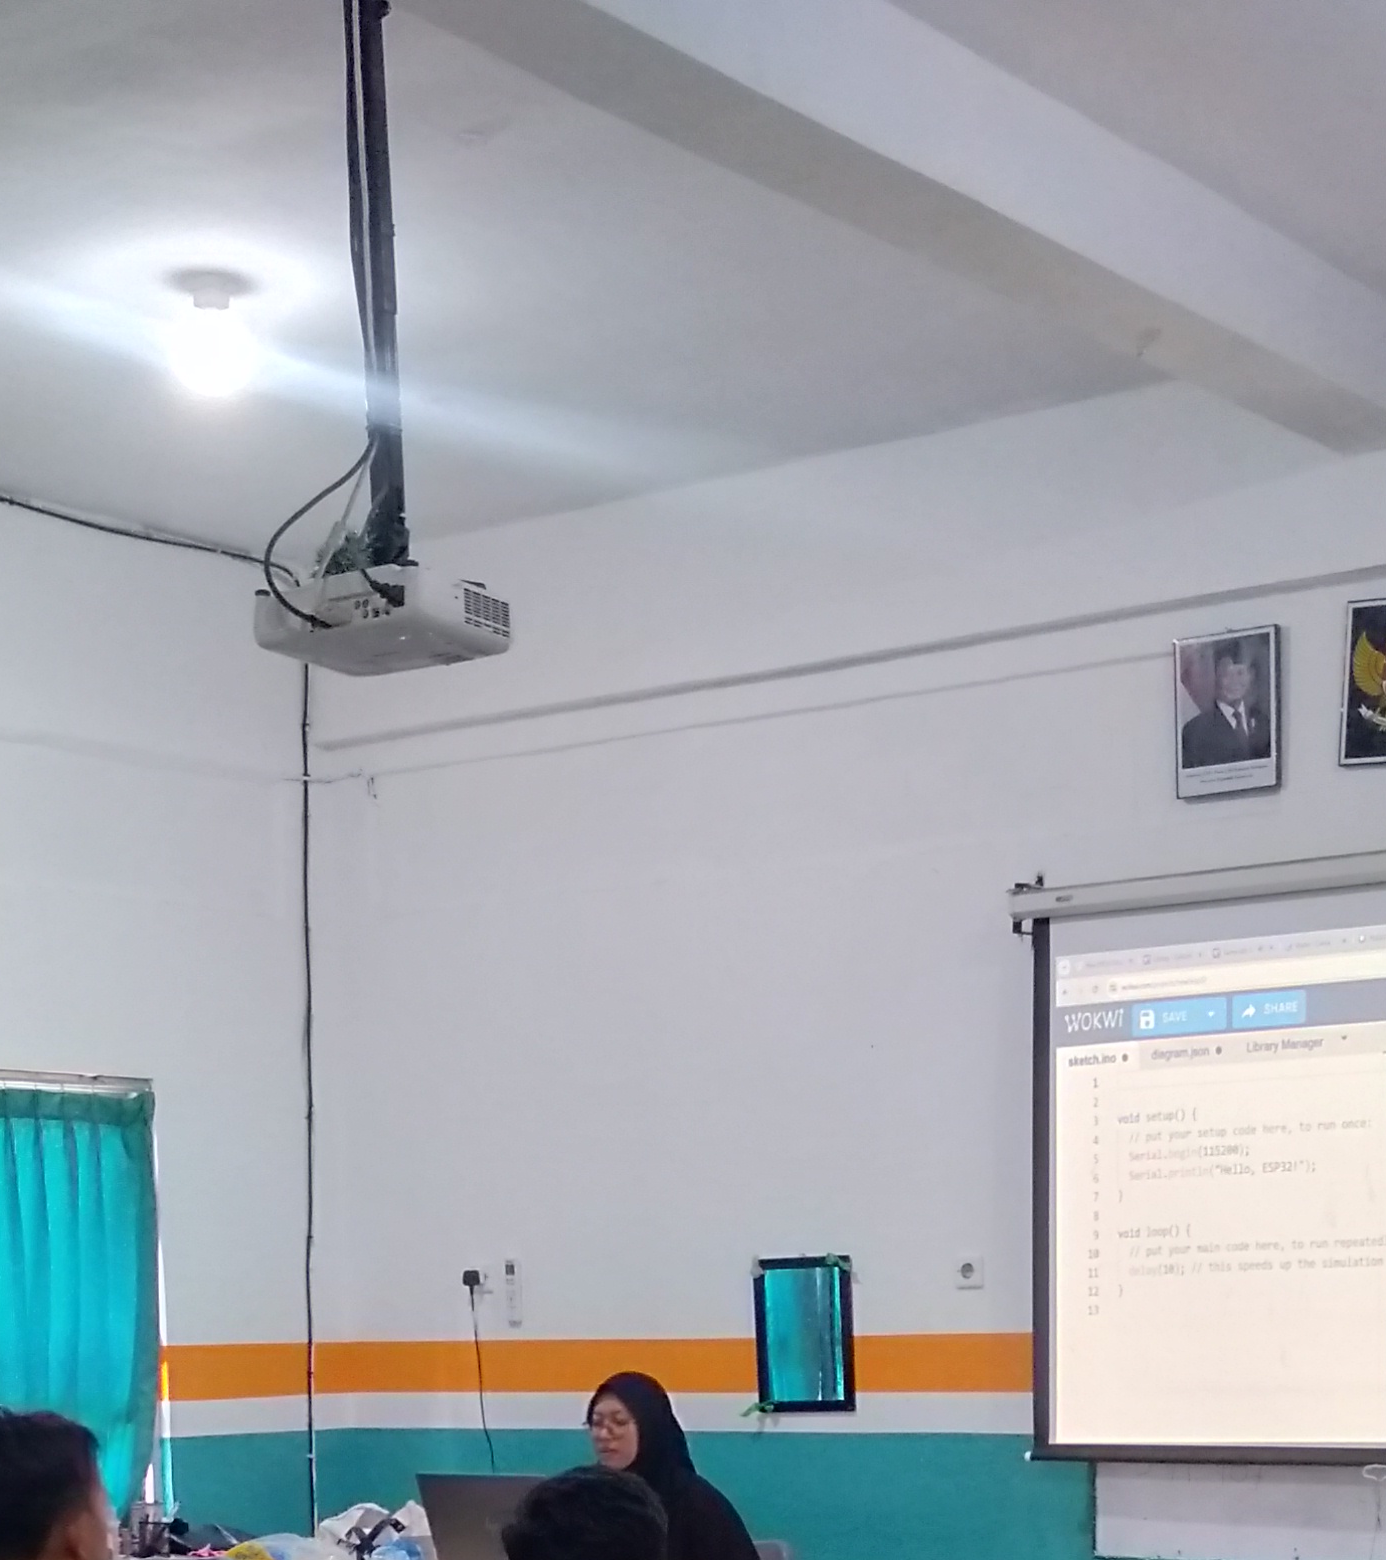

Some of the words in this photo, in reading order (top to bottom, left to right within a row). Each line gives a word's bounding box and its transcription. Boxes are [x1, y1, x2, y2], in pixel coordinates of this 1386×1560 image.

[1162, 1010, 1188, 1022] SAVE
[1263, 1001, 1299, 1015] SHARE
[1068, 1053, 1117, 1067] sketch.ino
[1151, 1045, 1209, 1062] diagram.json
[1246, 1041, 1279, 1054] Library
[1281, 1038, 1324, 1051] Manager
[1118, 1112, 1140, 1124] void
[1146, 1109, 1186, 1123] setup()
[1145, 1131, 1162, 1143] put
[1168, 1130, 1192, 1143] your
[1198, 1127, 1227, 1140] setup
[1233, 1124, 1257, 1136] code
[1299, 1121, 1311, 1132] to
[1317, 1120, 1336, 1130] run
[1118, 1227, 1141, 1239] void
[1146, 1245, 1162, 1258] put
[1168, 1245, 1192, 1257] your
[1226, 1241, 1250, 1252] code
[1291, 1239, 1304, 1250] to
[1310, 1239, 1329, 1249] run
[1209, 1261, 1232, 1273] this
[1238, 1260, 1273, 1273] speeds
[1280, 1260, 1292, 1272] up
[1298, 1258, 1316, 1269] the
[1322, 1256, 1383, 1269] simulation
